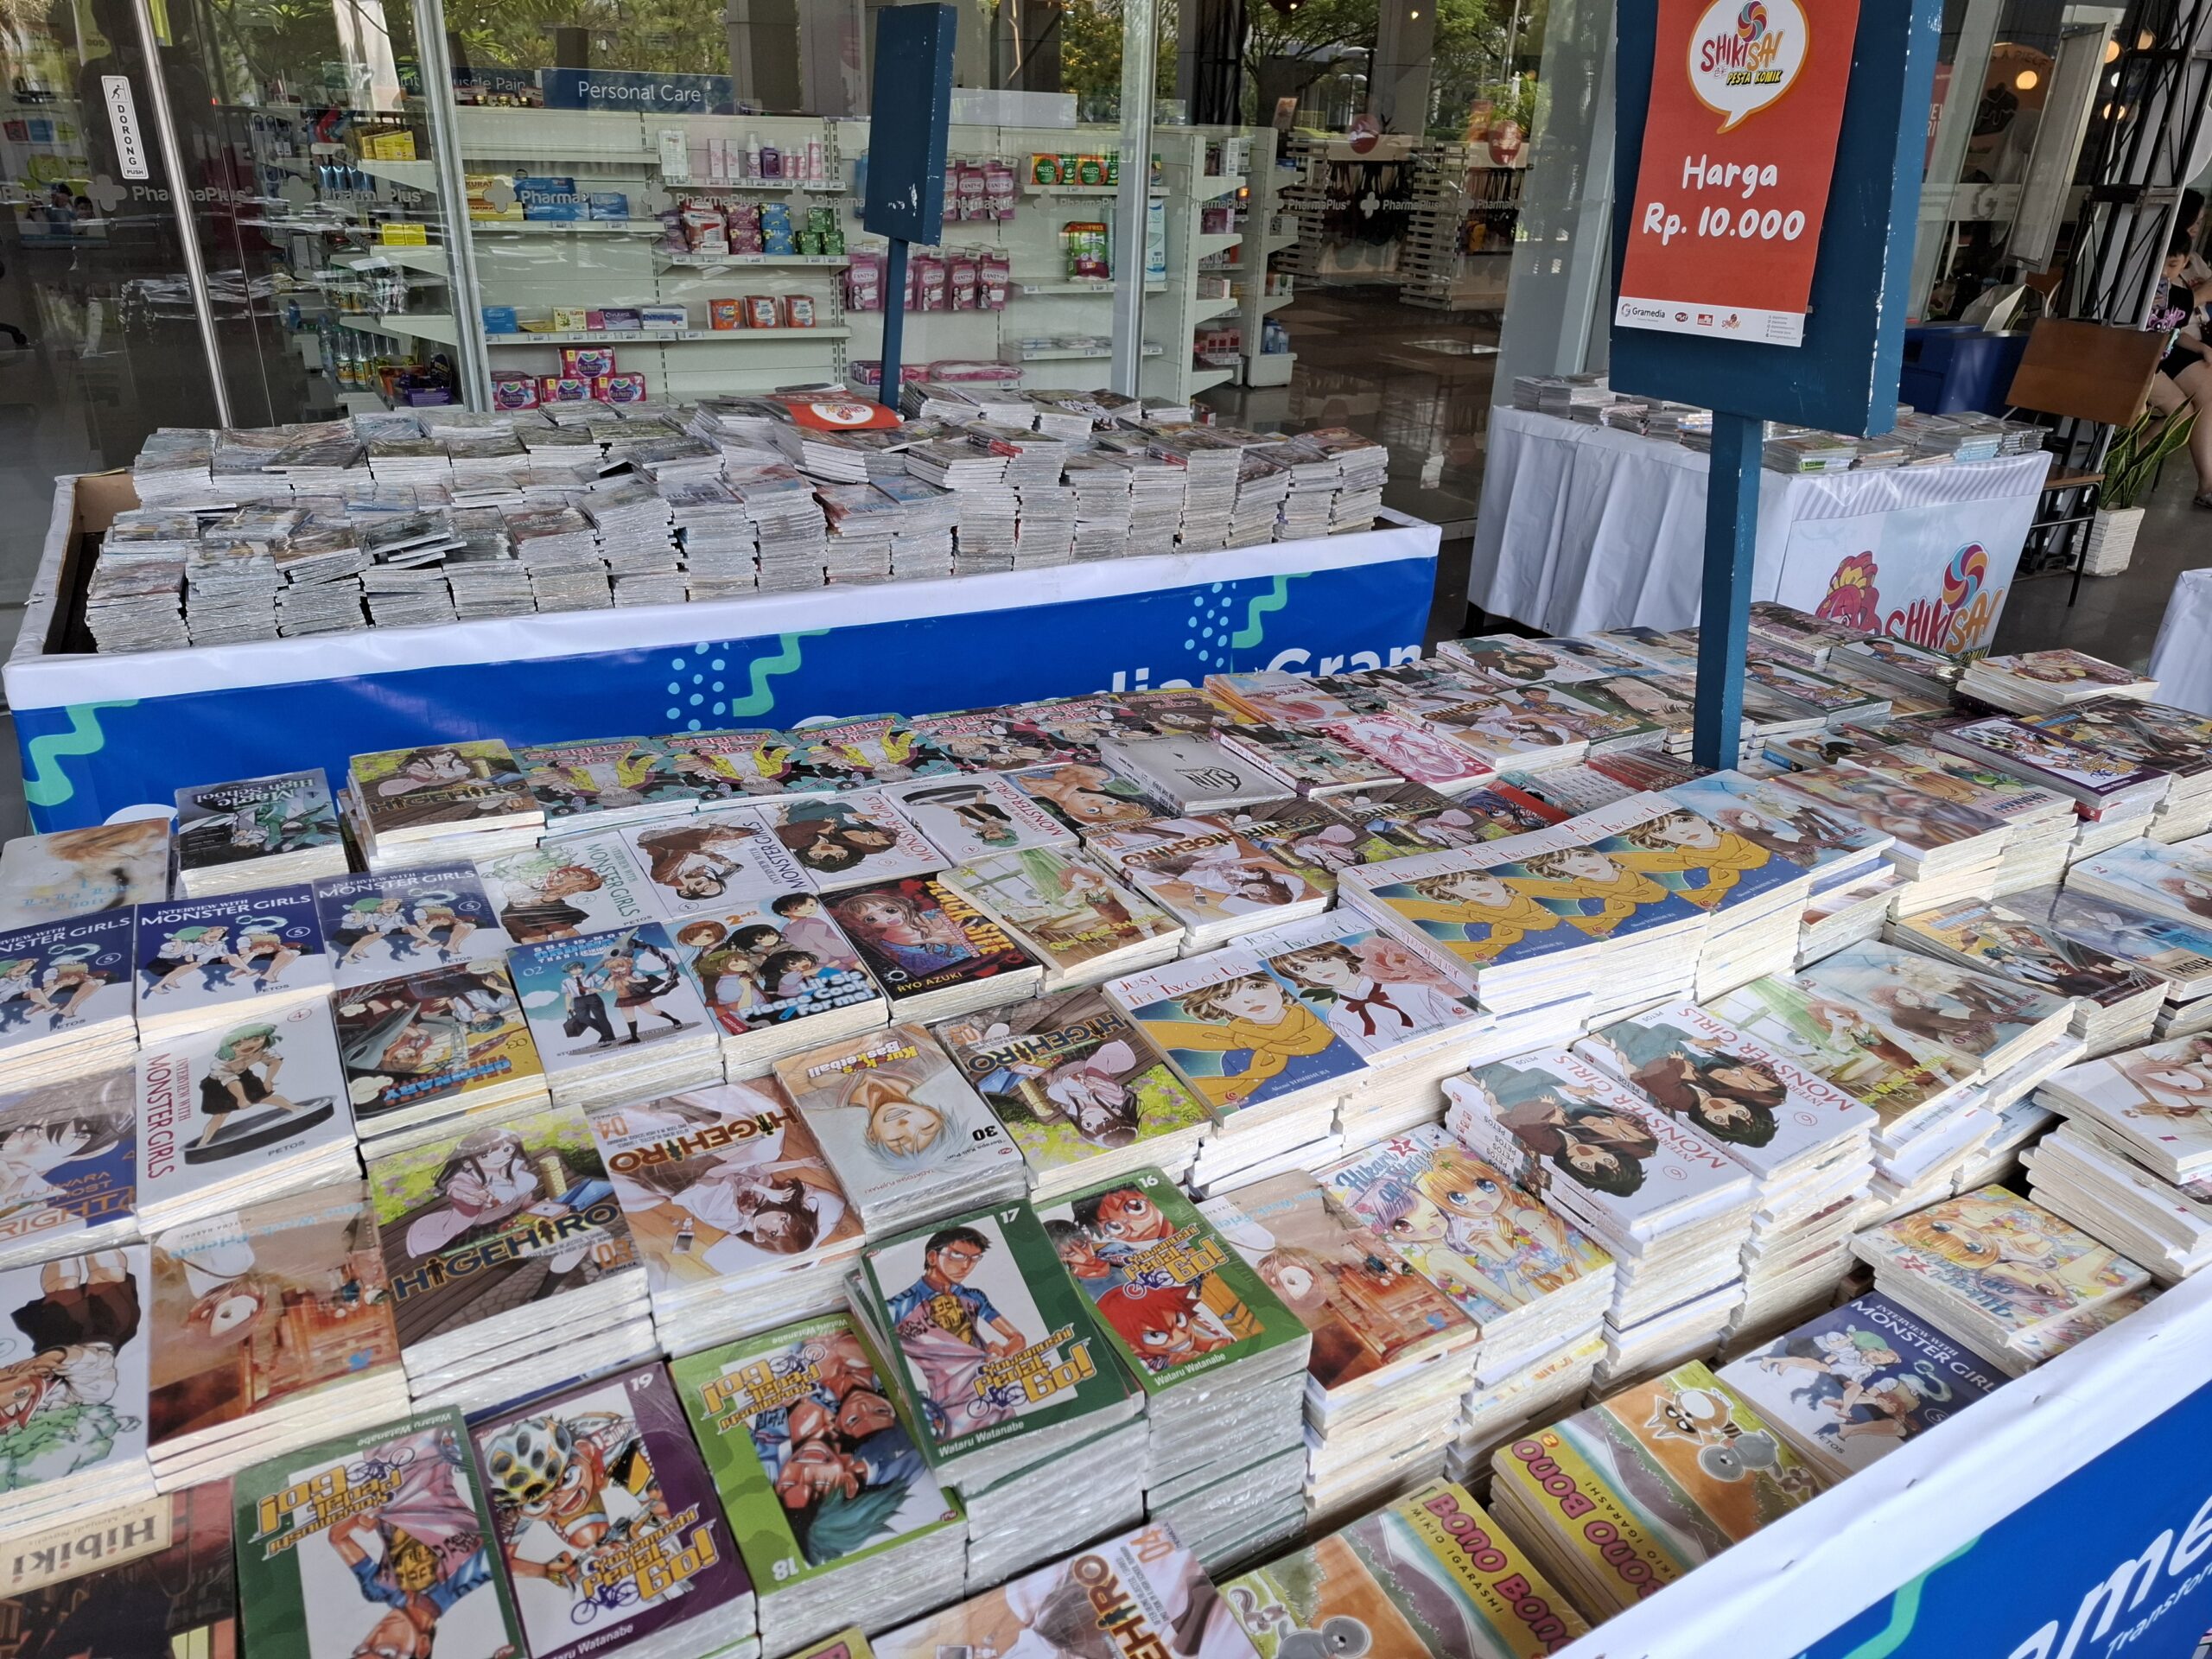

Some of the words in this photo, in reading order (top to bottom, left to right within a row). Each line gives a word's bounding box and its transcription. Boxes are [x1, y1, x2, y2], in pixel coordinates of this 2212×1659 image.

[1700, 29, 1785, 73] SHIKISAI
[452, 75, 491, 89] uscle
[495, 77, 526, 91] Pain
[1726, 71, 1751, 86] PESTA
[1754, 70, 1784, 84] KOMIK
[578, 80, 656, 102] Personal
[660, 84, 701, 103] Care
[118, 104, 137, 166] DORONG
[1681, 154, 1777, 199] Harga
[132, 187, 246, 202] PhamaPlus
[321, 187, 422, 204] PharmPlus
[677, 193, 760, 207] PharmaPlus
[1287, 199, 1347, 211] PharmaPlus
[1643, 202, 1687, 245] Rp.
[1698, 206, 1806, 241] 10.000
[1631, 307, 1666, 319] Gramedia
[196, 786, 261, 804] School
[217, 789, 296, 808] Magic
[266, 779, 316, 794] High
[1563, 817, 1597, 834] JUST
[1577, 830, 1604, 842] THE
[1649, 804, 1671, 817] US
[1461, 845, 1494, 858] JUST
[332, 875, 388, 887] INTERVIEW
[390, 872, 417, 880] WITH
[1351, 863, 1385, 877] JUST
[319, 878, 419, 899] MONSTER
[425, 870, 475, 884] GIRLS
[141, 905, 250, 925] MONSTER
[253, 895, 312, 911] GIRLS
[158, 903, 212, 917] INTERVIEW
[213, 899, 249, 910] WITH
[624, 915, 652, 925] PETOS
[35, 926, 67, 938] WITH
[70, 917, 130, 938] GIRLS
[1243, 931, 1280, 947] JUST
[1253, 943, 1281, 957] THE
[1283, 932, 1320, 949] TWO
[1321, 927, 1338, 938] OF
[1338, 922, 1365, 934] US
[827, 969, 863, 986] Sis
[898, 981, 922, 993] RYO
[925, 972, 963, 987] AZUKI
[1118, 973, 1159, 994] JUST
[1127, 992, 1154, 1007] THE
[1158, 979, 1200, 999] TWO
[1201, 974, 1220, 986] OF
[1220, 962, 1251, 977] US
[741, 995, 811, 1020] Please
[813, 980, 867, 1002] Cook
[798, 998, 831, 1018] For
[832, 988, 876, 1010] me!
[1641, 1010, 1664, 1022] PETOS
[1678, 1007, 1738, 1042] GIRLS
[968, 1013, 1126, 1073] HIGEHIRO
[808, 1040, 901, 1079] Basketball
[1515, 1055, 1539, 1065] PETOS
[176, 1056, 190, 1103] INTERVIEW
[1553, 1055, 1613, 1093] GIRLS
[1618, 1075, 1641, 1095] PETOS
[1738, 1041, 1855, 1113] MONSTER
[147, 1053, 172, 1129] MONSTER
[597, 1116, 629, 1140] 04
[972, 1125, 998, 1141] 30
[1484, 1116, 1506, 1136] PETOS
[1612, 1095, 1728, 1170] MONSTER
[267, 1139, 307, 1157] PETOS
[608, 1105, 800, 1173] HIGEHIRO
[1495, 1135, 1517, 1155] PETOS
[148, 1130, 175, 1179] GIRLS
[1137, 1174, 1159, 1188] 16
[1000, 1207, 1020, 1224] 17
[391, 1201, 621, 1301] HIGEHIRO
[1166, 1233, 1230, 1284] Go!
[772, 1326, 817, 1344] Watanabe
[1875, 1304, 1932, 1340] INTERVIEW
[1931, 1338, 1959, 1357] WITH
[1850, 1300, 1952, 1364] MONSTER
[1950, 1361, 1997, 1395] GIRL
[1021, 1338, 1097, 1403] Go!
[1154, 1368, 1185, 1387] Wataru
[1185, 1352, 1226, 1372] Watanabe
[631, 1372, 654, 1392] 19
[701, 1358, 776, 1421] Go!
[415, 1412, 453, 1432] Wataru
[356, 1423, 411, 1446] Watanabe
[938, 1437, 975, 1458] Wataru
[976, 1420, 1025, 1443] Watanabe
[1814, 1431, 1846, 1454] PETOS
[1511, 1439, 1597, 1521] BONO
[247, 1465, 346, 1544] Go!
[1422, 1491, 1508, 1573] BONO
[1586, 1481, 1643, 1544] IGARASHI
[1646, 1549, 1676, 1580] IKIO
[12, 1514, 156, 1584] Hibiki
[1129, 1529, 1176, 1564] 04
[635, 1518, 720, 1600] Go!
[772, 1557, 799, 1581] 18
[1411, 1507, 1446, 1545] MIKIO
[1446, 1549, 1503, 1613] IGARASHI
[578, 1623, 634, 1656] Watanabe
